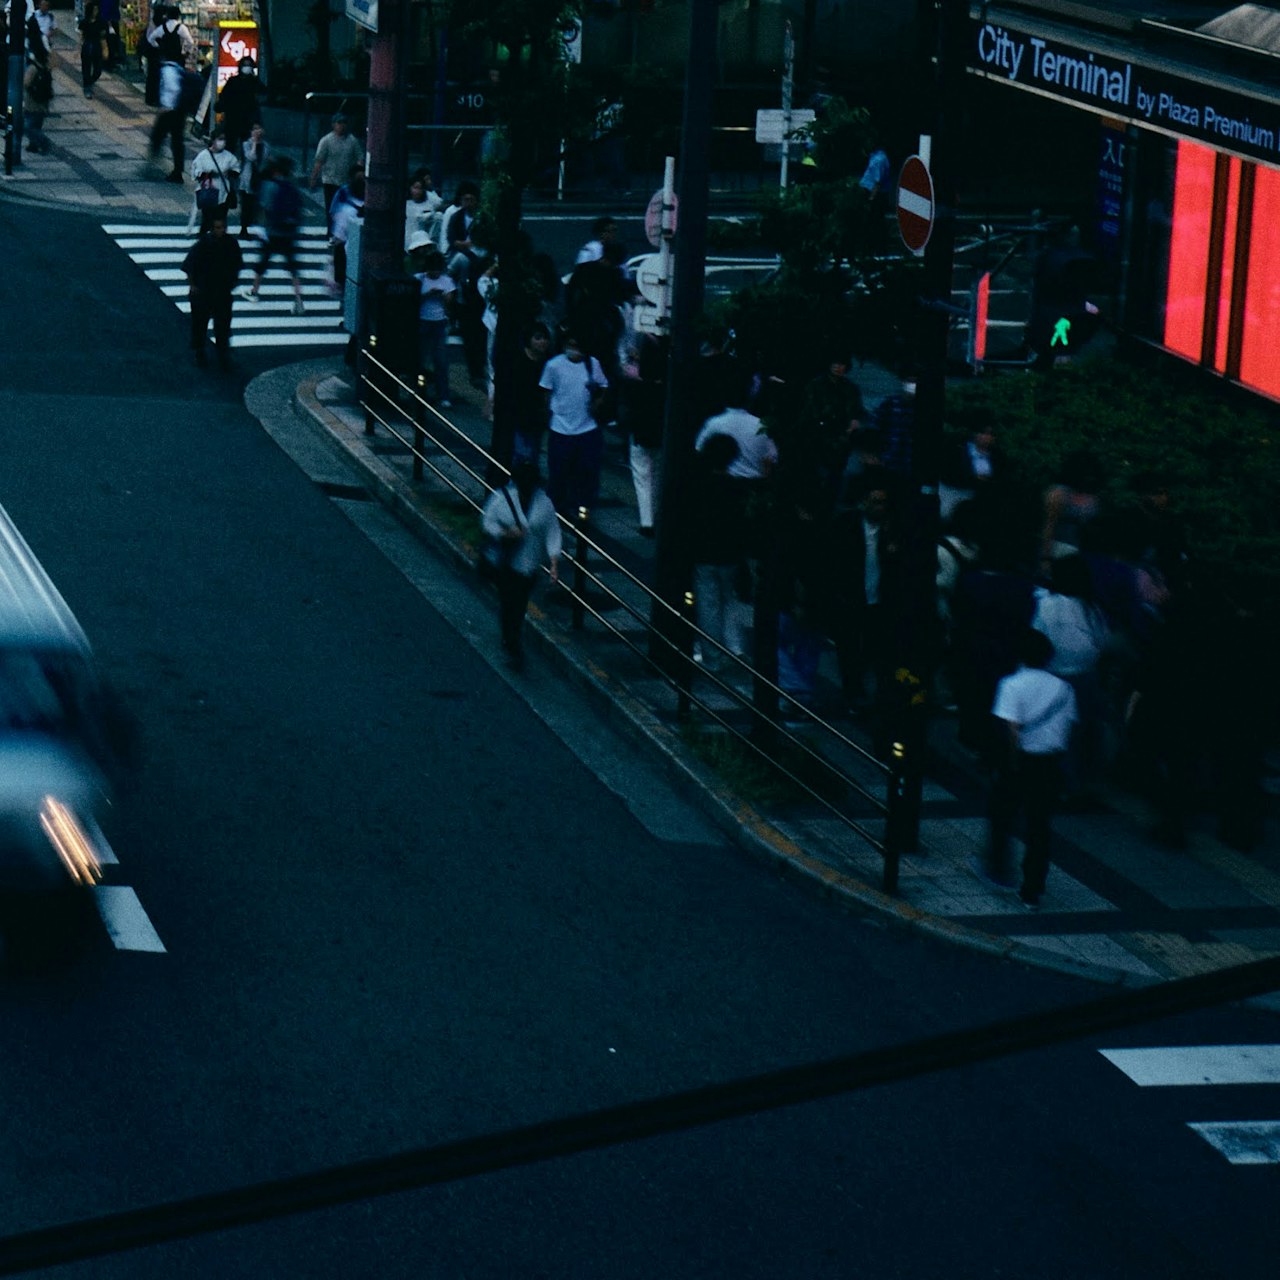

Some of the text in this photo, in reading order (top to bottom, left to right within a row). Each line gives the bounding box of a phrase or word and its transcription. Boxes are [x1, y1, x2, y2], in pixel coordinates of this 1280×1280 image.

[977, 23, 1275, 149] City Terminal by Plaza Premium
